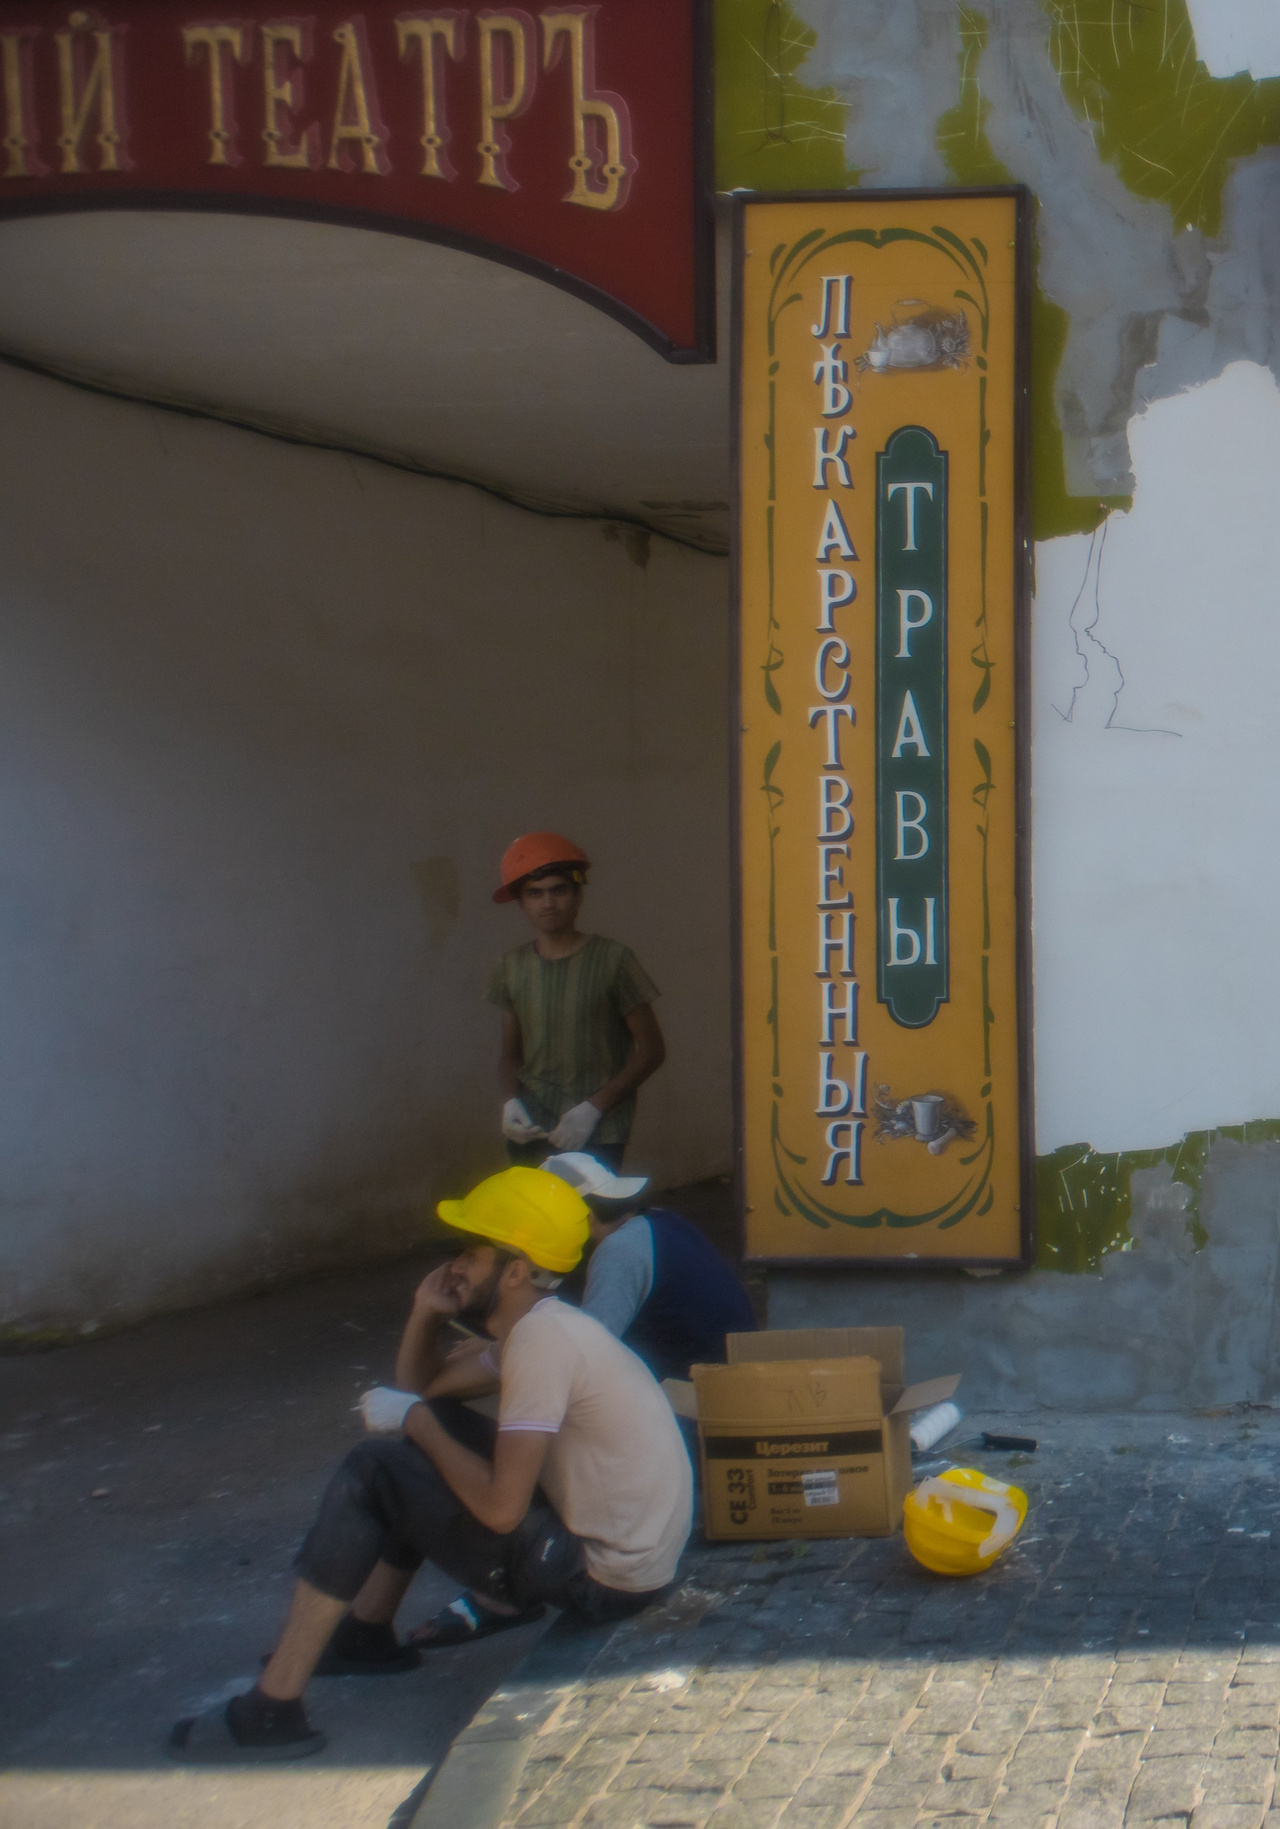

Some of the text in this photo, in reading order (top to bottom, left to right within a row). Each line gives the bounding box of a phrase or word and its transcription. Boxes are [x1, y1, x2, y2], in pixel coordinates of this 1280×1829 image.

[183, 7, 633, 212] ТЕАТРЪ
[887, 481, 938, 967] ТРАВЫ
[755, 1441, 829, 1456] Церезит
[839, 1465, 869, 1475] швов
[726, 1468, 748, 1525] CE 33
